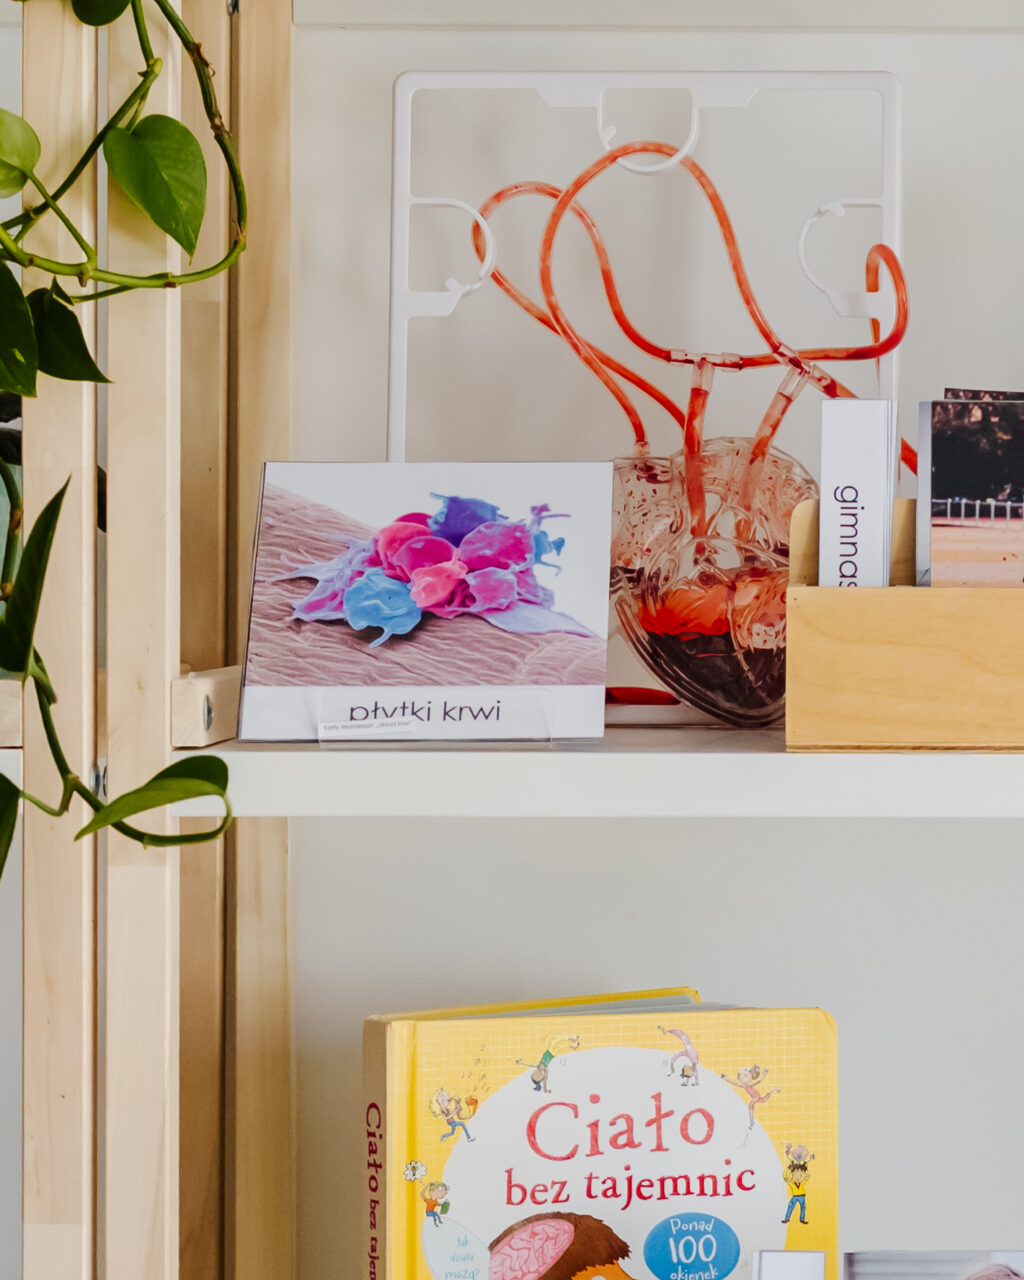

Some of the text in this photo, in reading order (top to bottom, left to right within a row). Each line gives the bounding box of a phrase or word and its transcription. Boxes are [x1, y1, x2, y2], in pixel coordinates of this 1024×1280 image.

[349, 700, 501, 721] płytki krwi
[526, 1091, 715, 1161] Ciało
[366, 1102, 383, 1193] Ciało
[505, 1158, 756, 1211] bez tajemnic
[369, 1198, 380, 1231] bez
[670, 1217, 715, 1235] Ponad
[669, 1234, 717, 1264] 100
